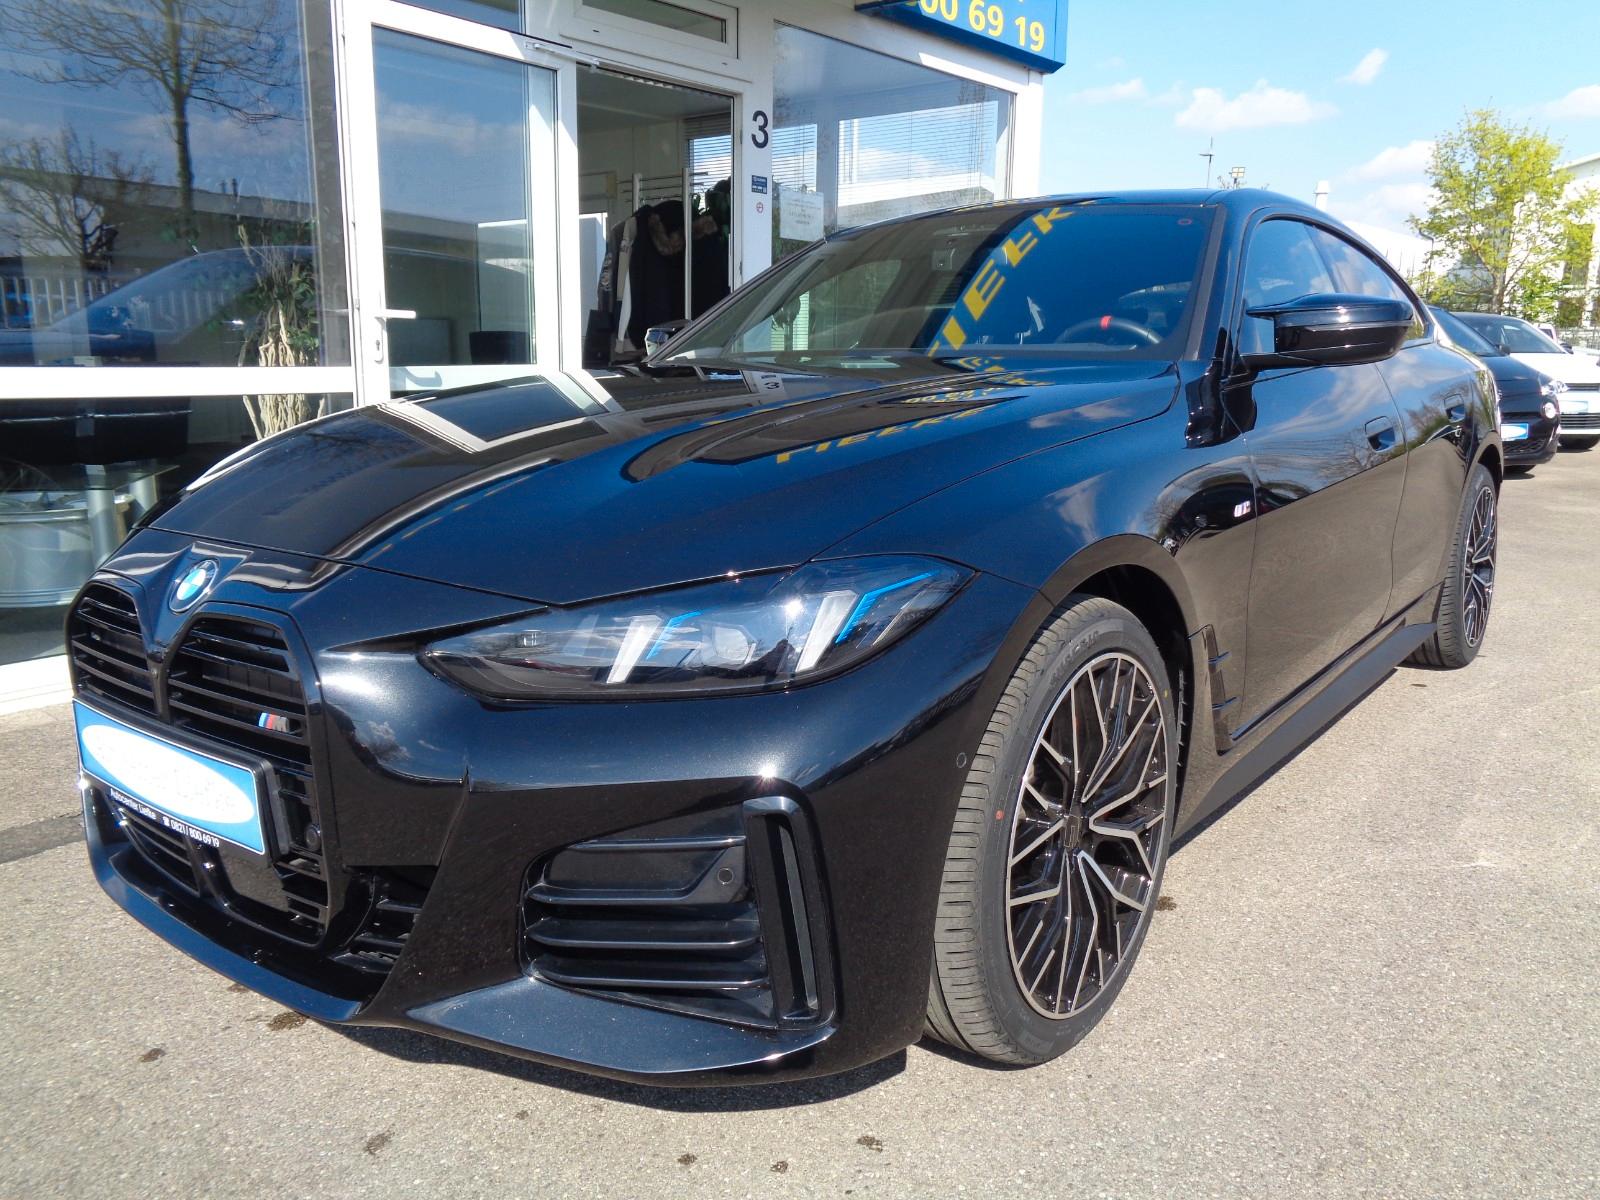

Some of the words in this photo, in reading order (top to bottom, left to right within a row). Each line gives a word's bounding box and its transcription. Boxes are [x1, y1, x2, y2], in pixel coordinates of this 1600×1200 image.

[968, 0, 1004, 37] 69
[1014, 16, 1045, 52] 19
[751, 110, 769, 149] 3
[189, 828, 202, 841] 800
[202, 833, 212, 844] 69
[211, 836, 219, 848] 19
